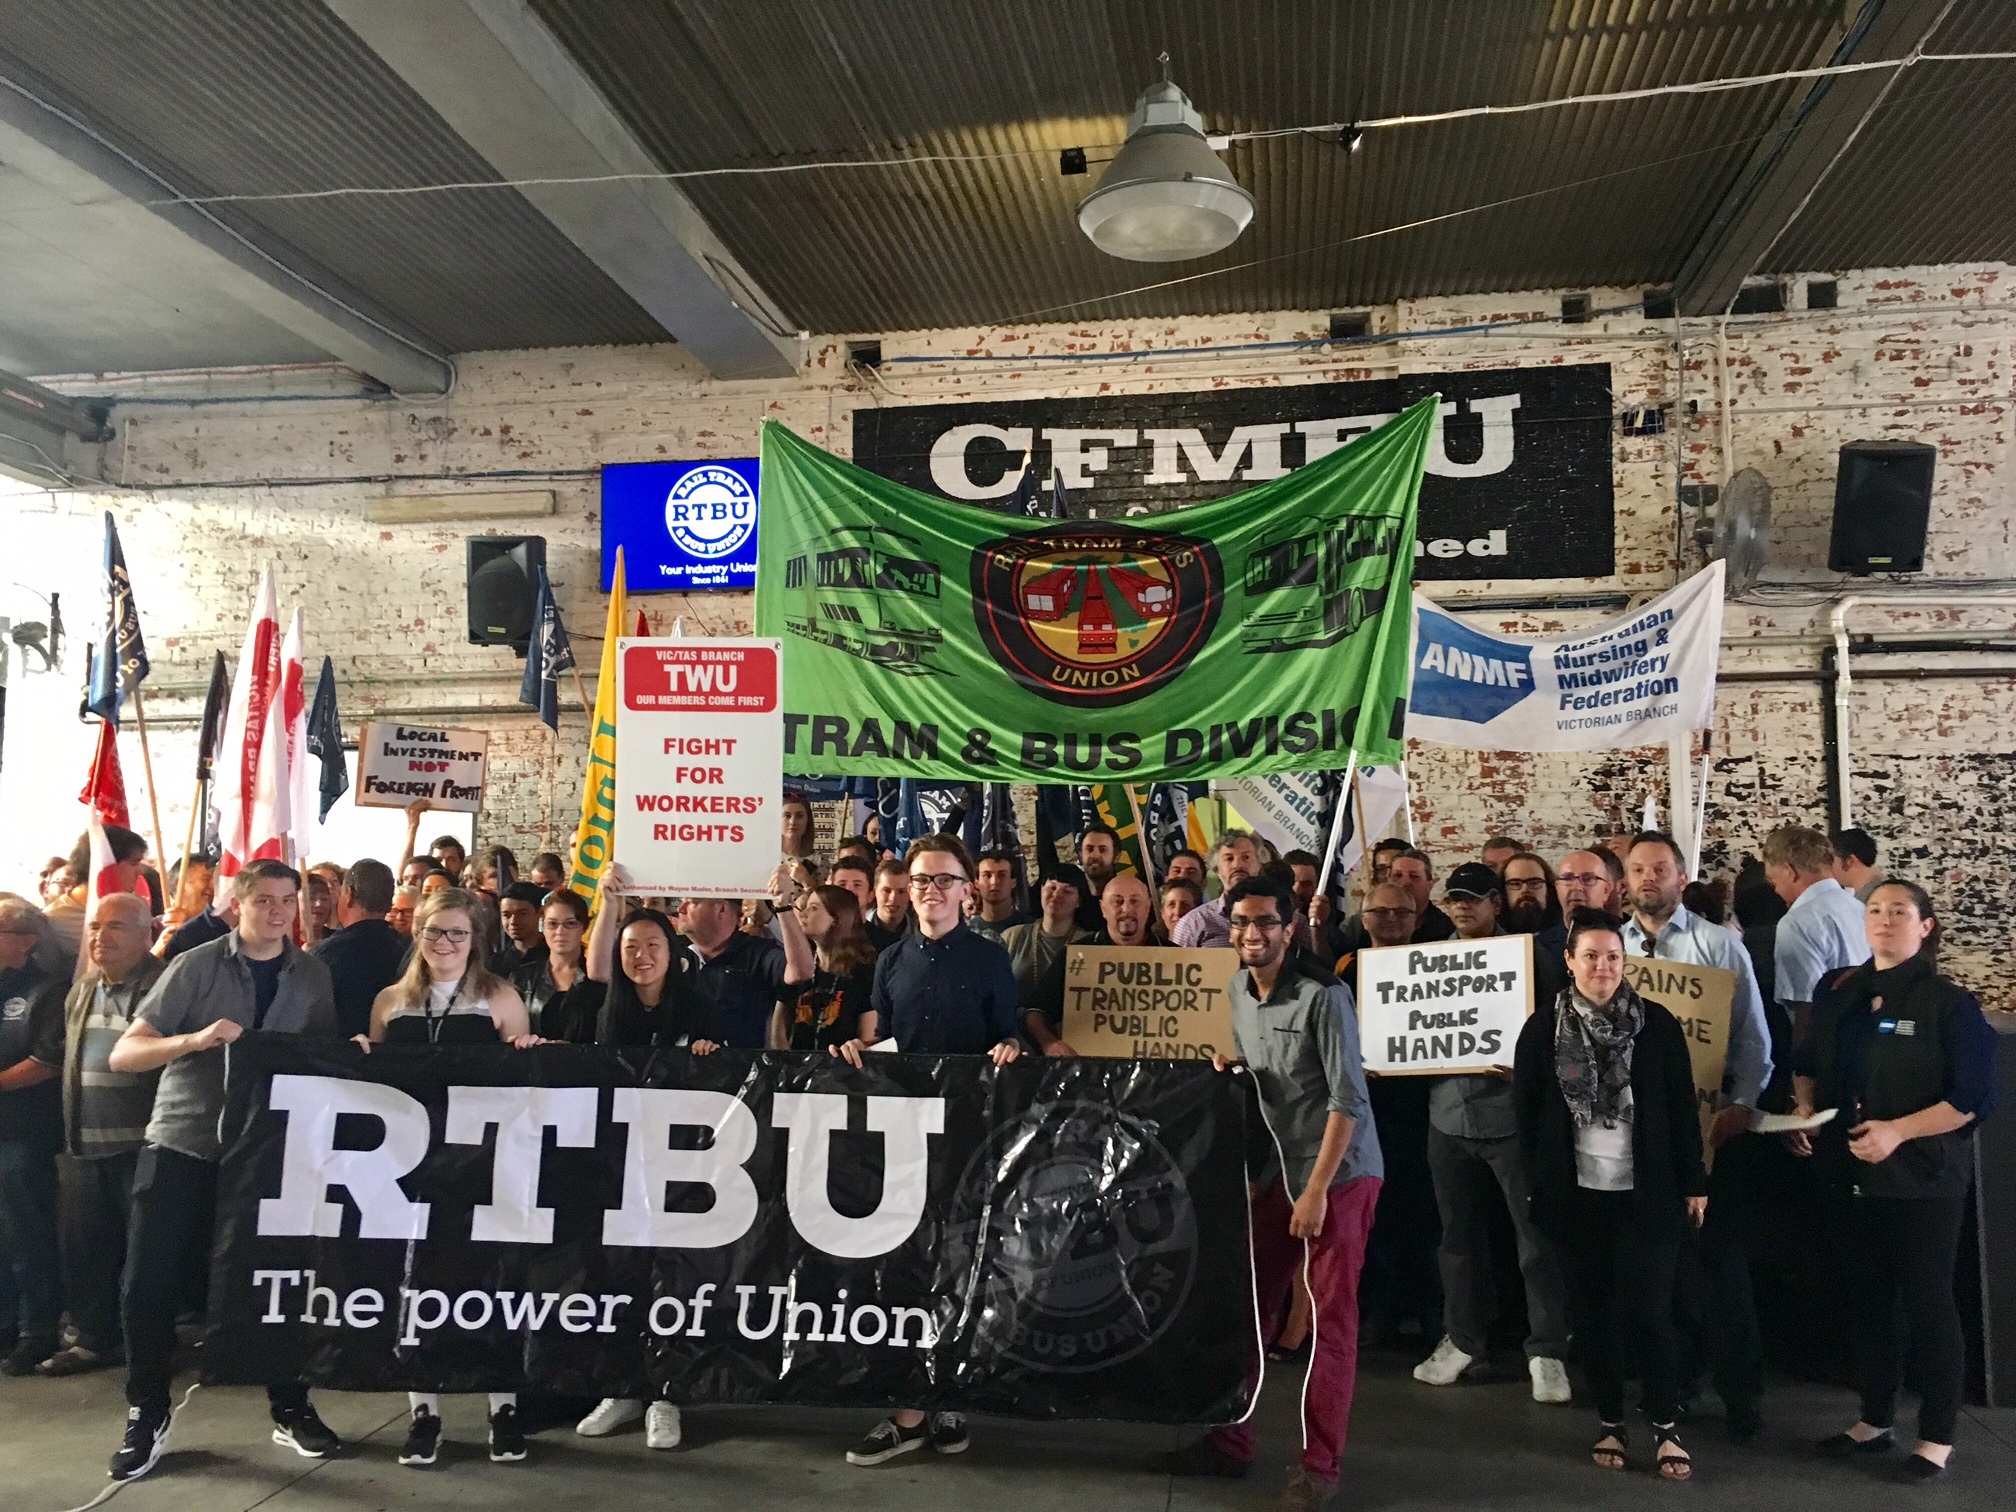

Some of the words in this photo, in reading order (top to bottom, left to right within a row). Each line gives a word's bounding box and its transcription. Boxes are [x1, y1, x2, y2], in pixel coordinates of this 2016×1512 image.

[677, 473, 707, 498] RAIL
[672, 501, 749, 521] RTBU
[659, 564, 684, 575] Your
[685, 563, 728, 576] Industry
[691, 576, 711, 584] Since
[656, 651, 697, 661] VIC/TAS
[701, 651, 744, 661] BRANCH
[1554, 640, 1648, 670] Nursing
[1654, 627, 1670, 646] &
[1051, 664, 1141, 687] UNION
[1420, 642, 1528, 688] ANMF
[1557, 653, 1670, 690] Midwifery
[664, 664, 738, 692] TWU
[636, 695, 656, 705] OUR
[658, 696, 706, 706] MEMBERS
[708, 697, 736, 706] COME
[738, 697, 764, 706] FIRST
[1559, 676, 1678, 711] Federation
[1556, 712, 1622, 731] VICTORIAN
[1626, 703, 1678, 722] BRANCH
[663, 738, 737, 756] FIGHT
[783, 713, 940, 761] TRAM
[960, 728, 1000, 766] &
[1020, 731, 1143, 772] BUS
[408, 761, 450, 772] NOT
[676, 766, 724, 784] FOR
[635, 794, 763, 814] WORKERS'
[1235, 775, 1275, 813] TORIAN
[1273, 809, 1316, 851] BRANCH
[653, 824, 745, 843] RIGHTS
[668, 885, 689, 893] Wayne
[740, 886, 769, 895] Secretar
[1068, 958, 1087, 976] #
[1097, 961, 1203, 987] PUBLIC
[1408, 949, 1488, 976] PUBLIC
[1069, 986, 1222, 1012] TRANSPORT
[1376, 971, 1517, 1005] TRANSPORT
[1093, 1013, 1179, 1038] PUBLIC
[1408, 1007, 1479, 1031] PUBLIC
[1132, 1040, 1216, 1061] HANDS
[1387, 1029, 1503, 1063] HANDS
[256, 1072, 946, 1259] RTBU
[253, 1269, 384, 1328] The
[400, 1292, 632, 1346] power
[648, 1284, 716, 1338] of
[735, 1285, 936, 1349] Union
